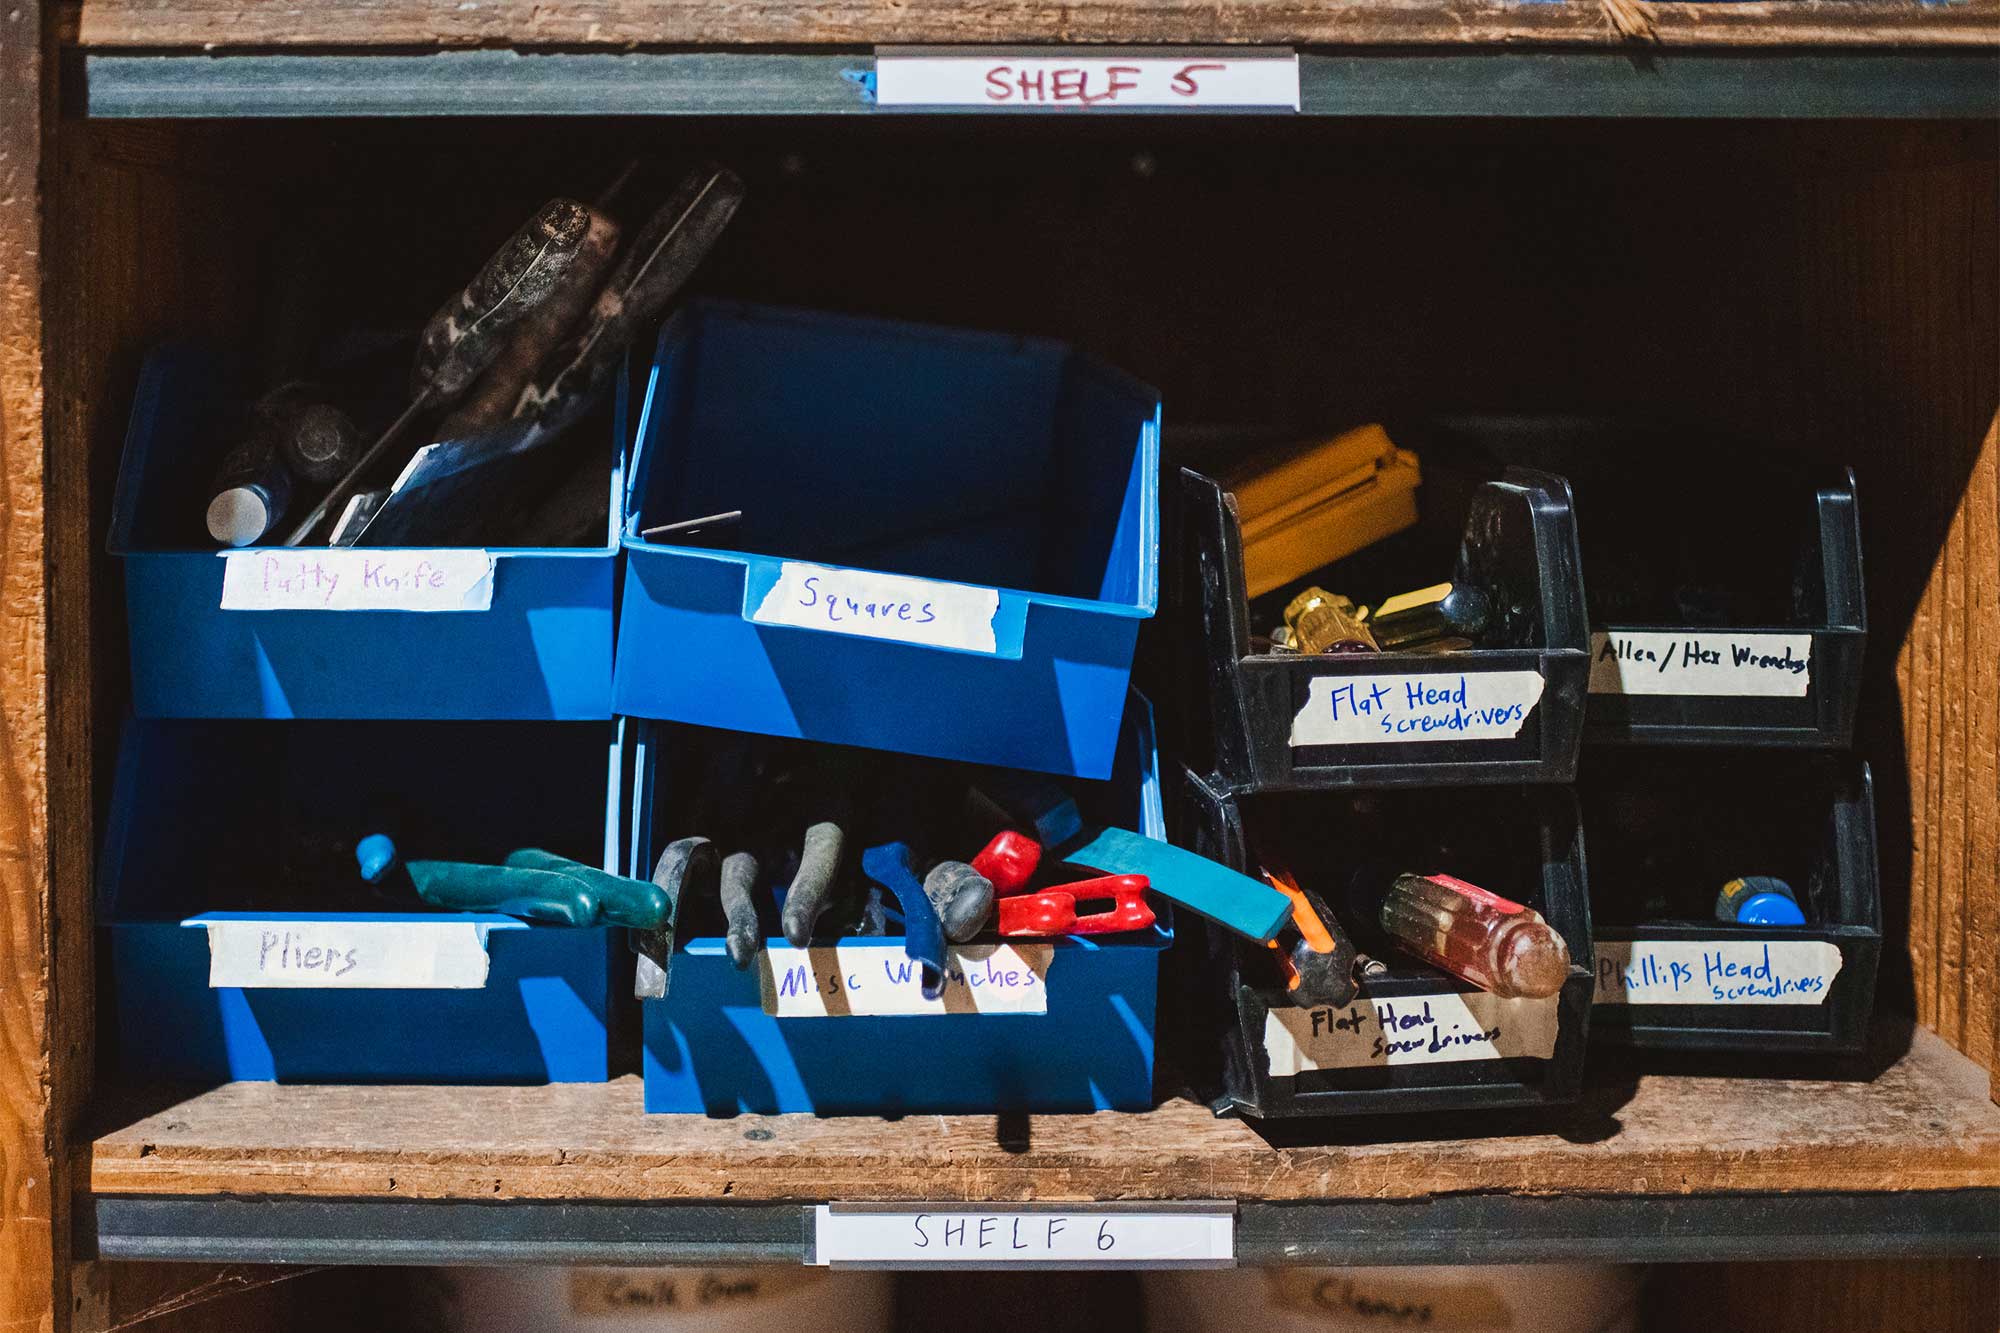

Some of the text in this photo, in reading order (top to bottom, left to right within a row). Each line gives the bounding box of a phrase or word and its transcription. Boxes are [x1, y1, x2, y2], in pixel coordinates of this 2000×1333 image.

[985, 64, 1226, 103] SHELF 5
[263, 556, 448, 605] Putty Knife
[799, 577, 936, 623] Squares
[1331, 676, 1468, 721] Flat Head
[259, 930, 357, 977] Pliers
[1703, 943, 1773, 986] Head
[779, 958, 1035, 998] Misc Wnches
[1310, 1008, 1367, 1038] Flat
[913, 1213, 1115, 1251] SHELF 6
